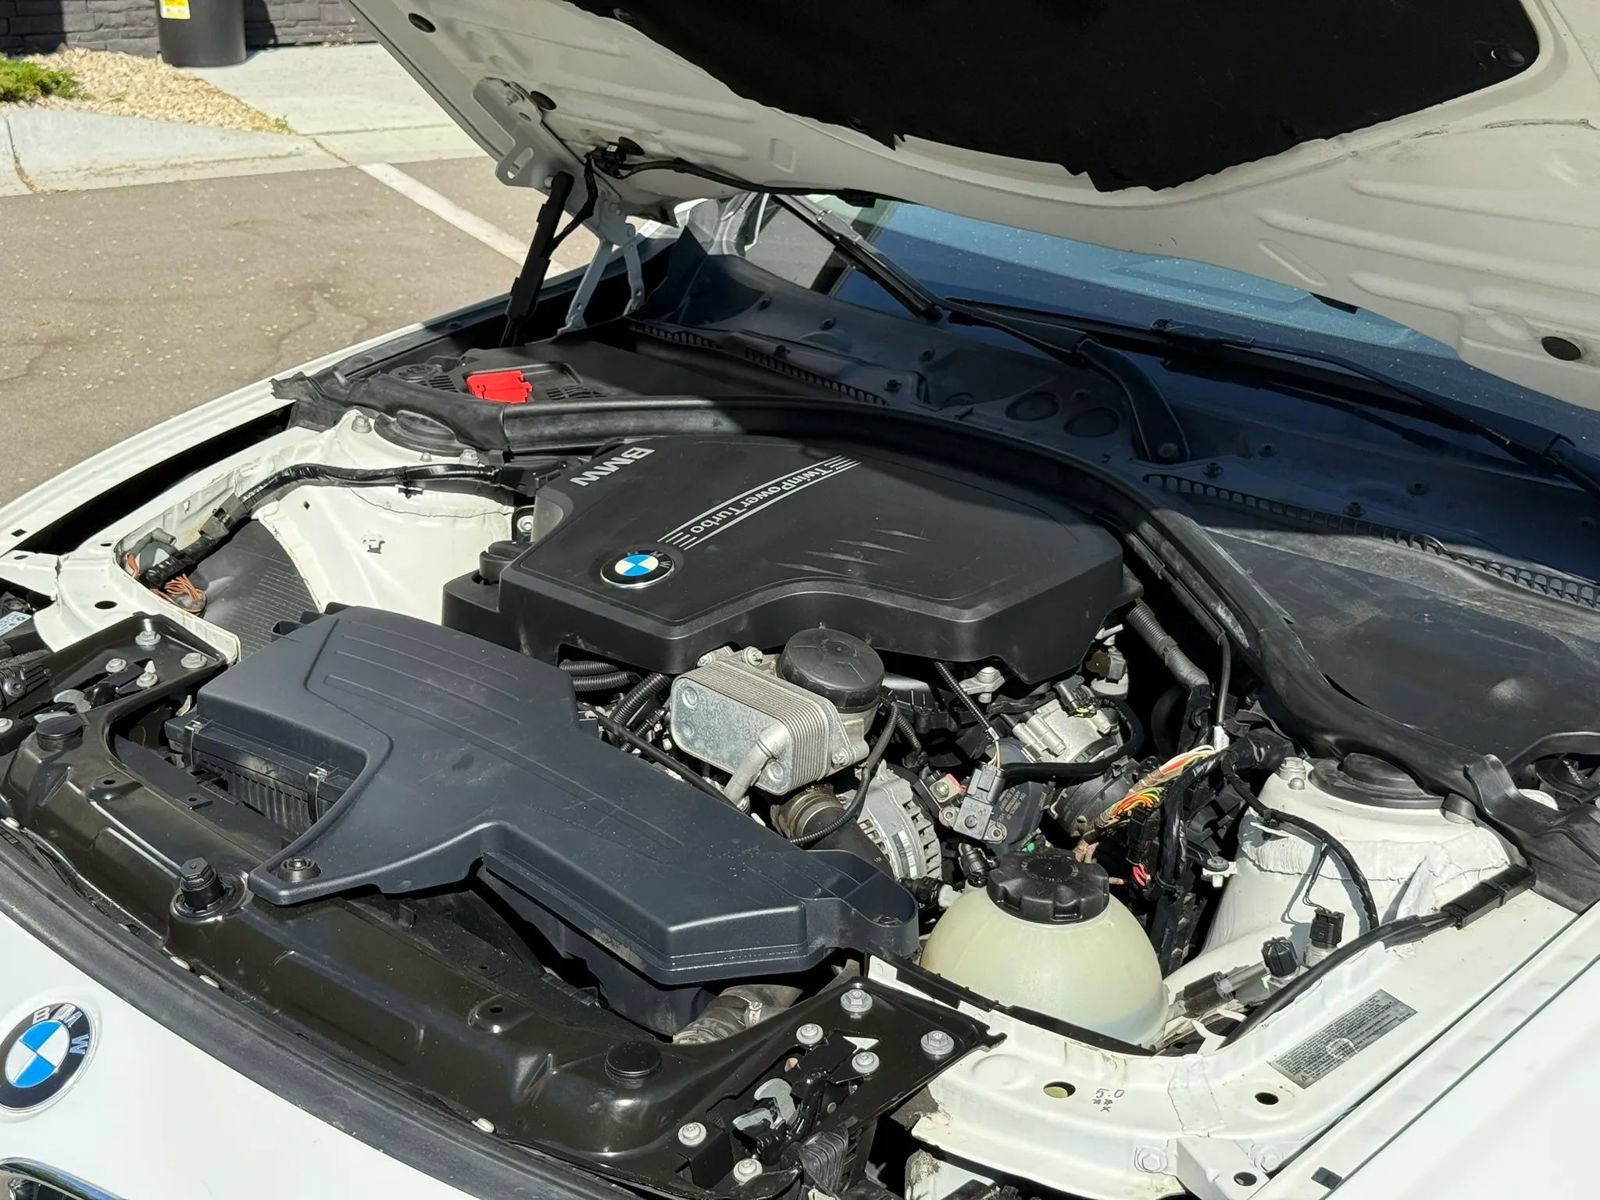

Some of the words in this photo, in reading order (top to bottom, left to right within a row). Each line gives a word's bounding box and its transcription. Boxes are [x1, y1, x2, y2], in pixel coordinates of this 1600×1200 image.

[569, 447, 655, 487] BMW
[740, 467, 833, 507] TwinPower
[690, 506, 747, 533] Turbo
[32, 1003, 89, 1055] BMW
